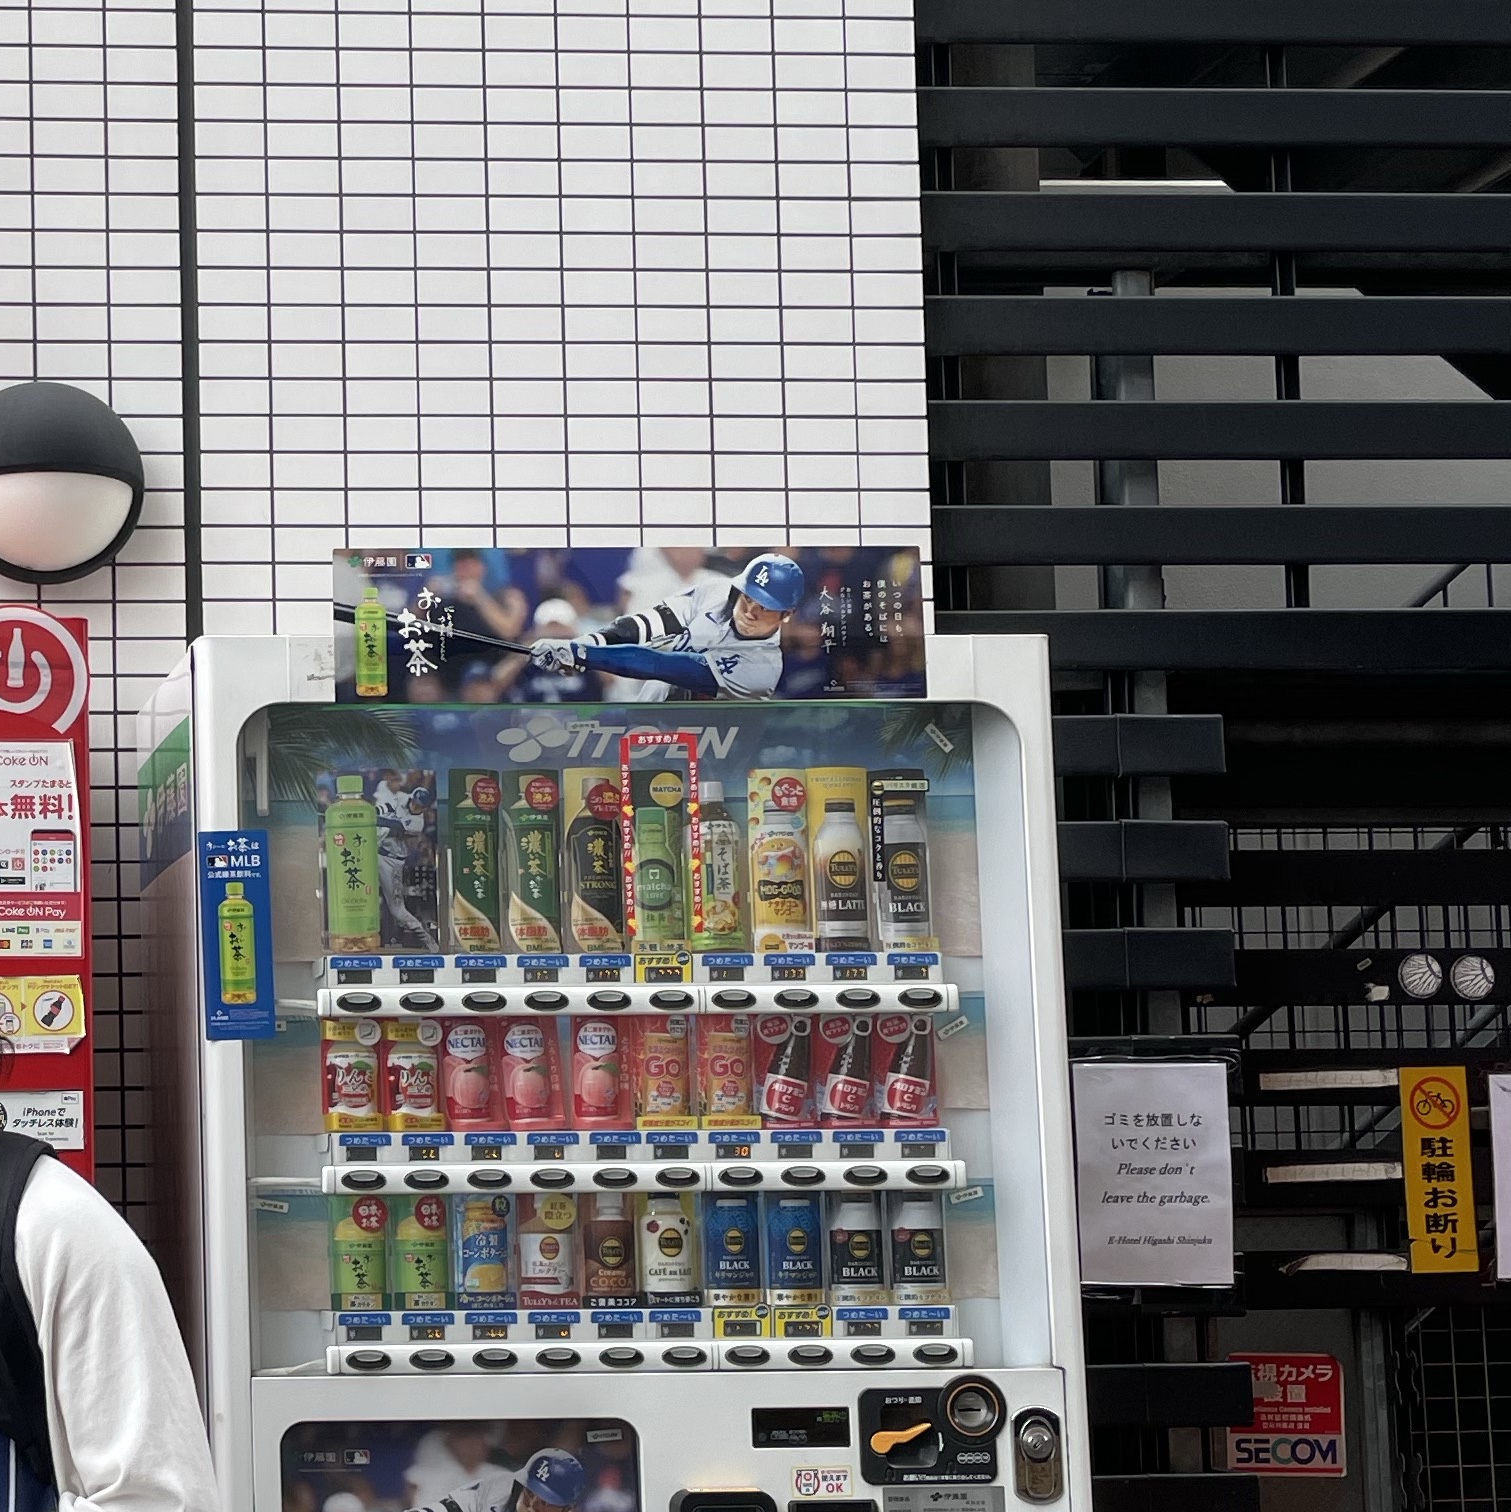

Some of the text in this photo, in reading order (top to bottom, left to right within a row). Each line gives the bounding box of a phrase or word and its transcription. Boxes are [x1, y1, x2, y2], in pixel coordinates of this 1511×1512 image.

[363, 556, 397, 567] 伊藤園
[862, 579, 873, 638] お茶がある。
[877, 579, 888, 643] 僕のそばには
[892, 580, 904, 638] いつの日も、
[819, 585, 837, 654] 大谷翔平
[28, 754, 49, 766] ON
[10, 779, 73, 789] スタンプたまると
[872, 798, 883, 880] 圧倒的なコクと香り
[230, 855, 261, 868] MLB
[716, 845, 733, 891] そば茶
[207, 870, 262, 879] 公式緑茶飲料です。
[579, 880, 617, 890] STRONG
[637, 881, 672, 892] matcha
[26, 905, 43, 916] ON
[45, 907, 66, 919] Pay
[773, 908, 795, 916] マンゴー
[888, 902, 925, 913] BLACK
[514, 926, 548, 938] 体脂肪
[577, 926, 609, 937] 体脂肪
[638, 957, 675, 966] おすすめ!
[644, 1053, 681, 1079] GO
[709, 1053, 745, 1079] GO
[771, 1083, 806, 1098] オロナミン
[836, 1082, 868, 1097] オロナミン
[893, 1081, 927, 1097] オロナミン
[846, 1094, 856, 1103] C
[903, 1093, 913, 1102] C
[22, 1107, 66, 1117] iPhoneで
[840, 1102, 859, 1111] ドリンク
[898, 1102, 916, 1111] ドリンク
[12, 1118, 80, 1128] タッチレス体験!
[1104, 1112, 1203, 1127] ゴミを放置しな
[1111, 1137, 1197, 1150] いでください
[1116, 1163, 1156, 1176] Please
[1101, 1190, 1210, 1207] leave the garbage.
[1420, 1136, 1459, 1259] 駐輪お断り
[475, 1234, 499, 1247] 冷製
[1107, 1235, 1213, 1247] E-Hotel Higashi Shinjuku
[463, 1247, 507, 1259] コーンポタージュ
[782, 1260, 813, 1270] BLACK
[904, 1265, 940, 1276] BLACK
[648, 1267, 668, 1276] CAFÉ
[842, 1266, 878, 1277] BLACK
[590, 1278, 633, 1287] COCOA
[560, 1296, 579, 1306] TEA
[590, 1297, 637, 1306] ご褒美ココア
[713, 1293, 756, 1301] 華やかな香り
[776, 1293, 818, 1301] 華やかな香り
[1235, 1437, 1338, 1465] SECOM
[303, 1452, 336, 1463] 伊藤園
[825, 1483, 844, 1493] OK
